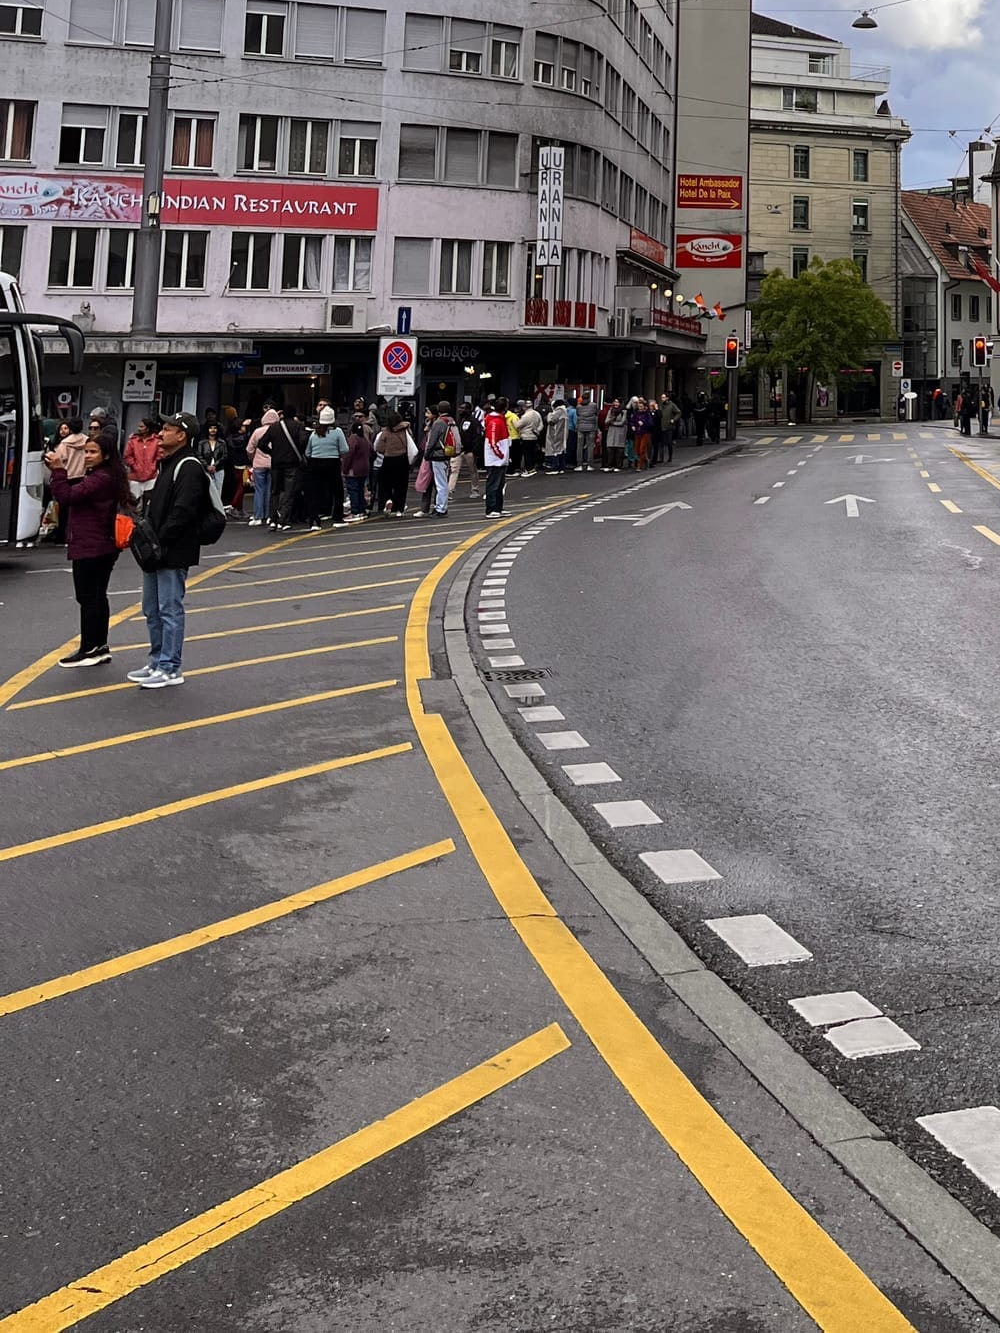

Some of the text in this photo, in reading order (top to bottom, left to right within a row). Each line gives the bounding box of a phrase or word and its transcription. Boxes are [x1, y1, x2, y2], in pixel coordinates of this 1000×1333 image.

[679, 188, 697, 198] Hotel
[699, 188, 709, 198] De
[680, 177, 740, 188] Hotel Ambassador
[73, 186, 357, 216] KANCH INDIAN RESTAURANT
[538, 153, 549, 260] URANIA
[550, 152, 562, 260] URANIA
